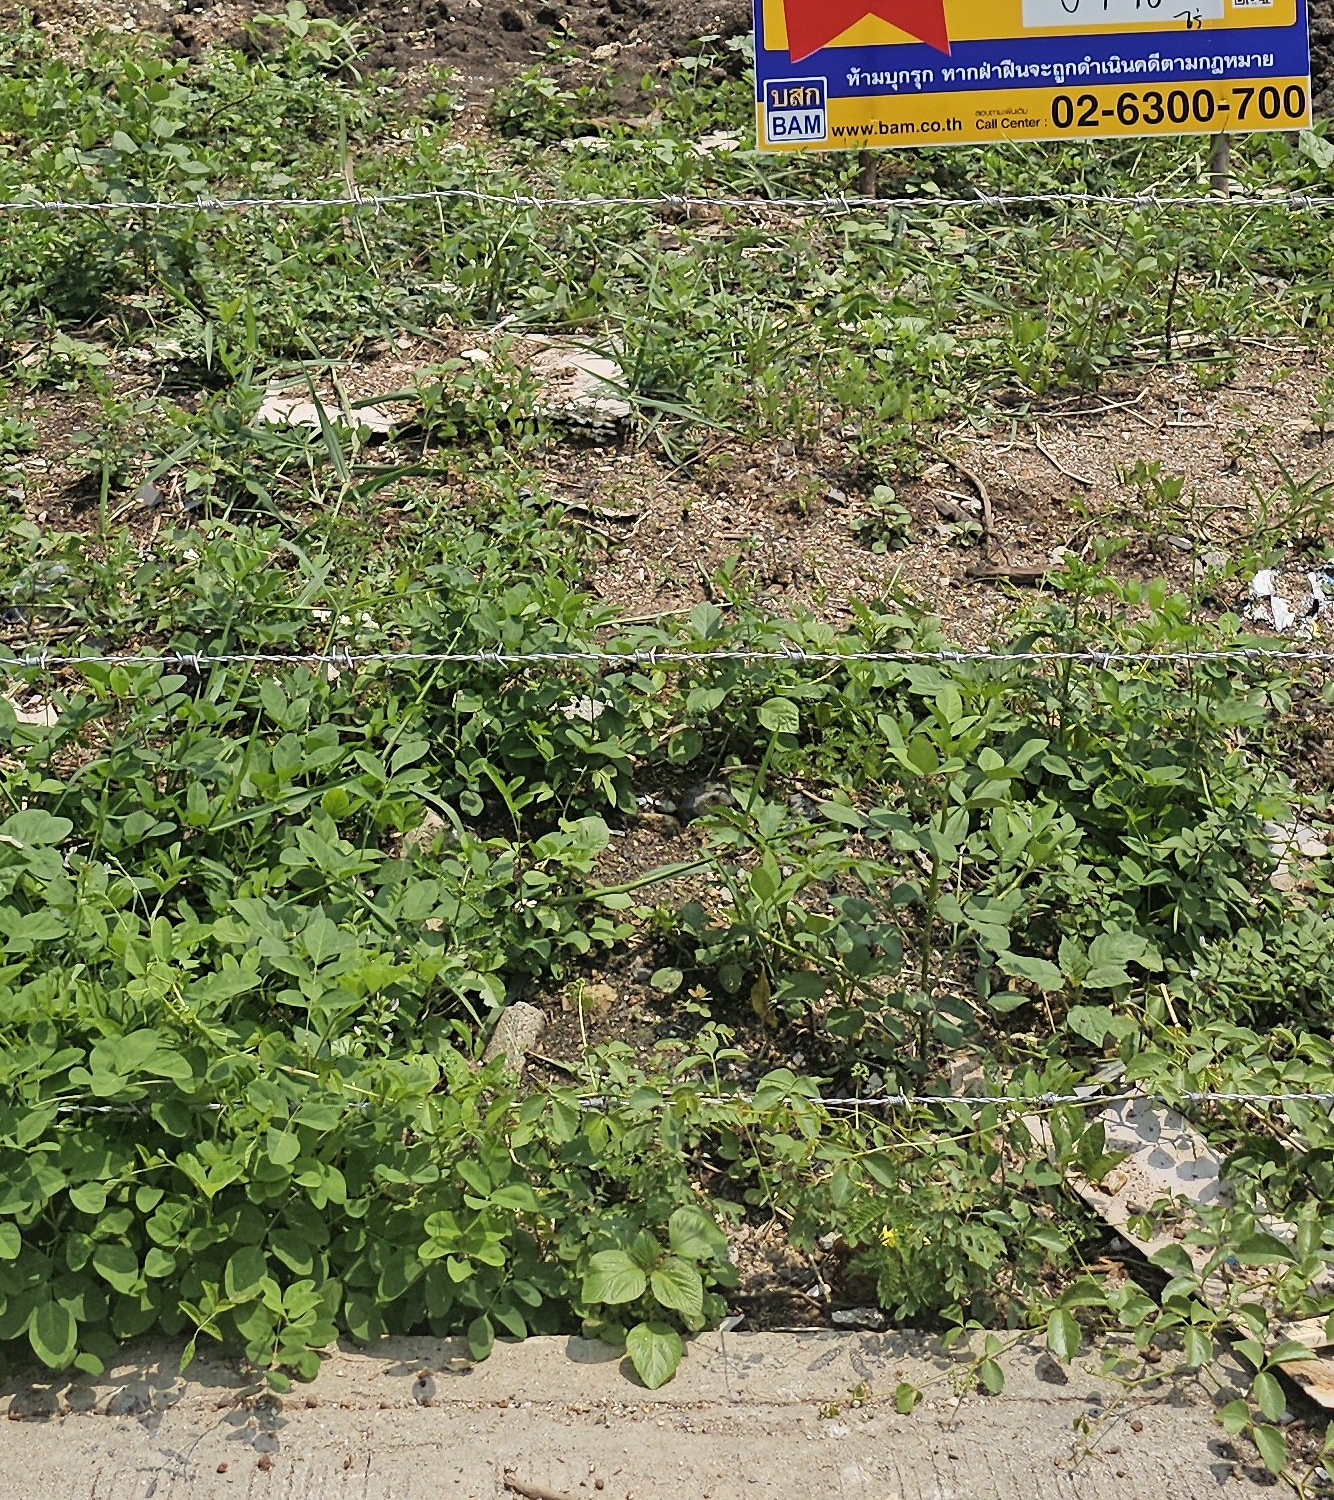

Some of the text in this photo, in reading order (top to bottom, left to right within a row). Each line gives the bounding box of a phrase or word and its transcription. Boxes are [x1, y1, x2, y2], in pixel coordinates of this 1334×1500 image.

[845, 67, 934, 91] ห้ามบุกรุก
[770, 86, 821, 108] บสก
[1051, 85, 1306, 128] 02-6300-700
[772, 114, 821, 136] BAM
[831, 117, 962, 137] www.bam.co.th
[975, 118, 998, 130] Call
